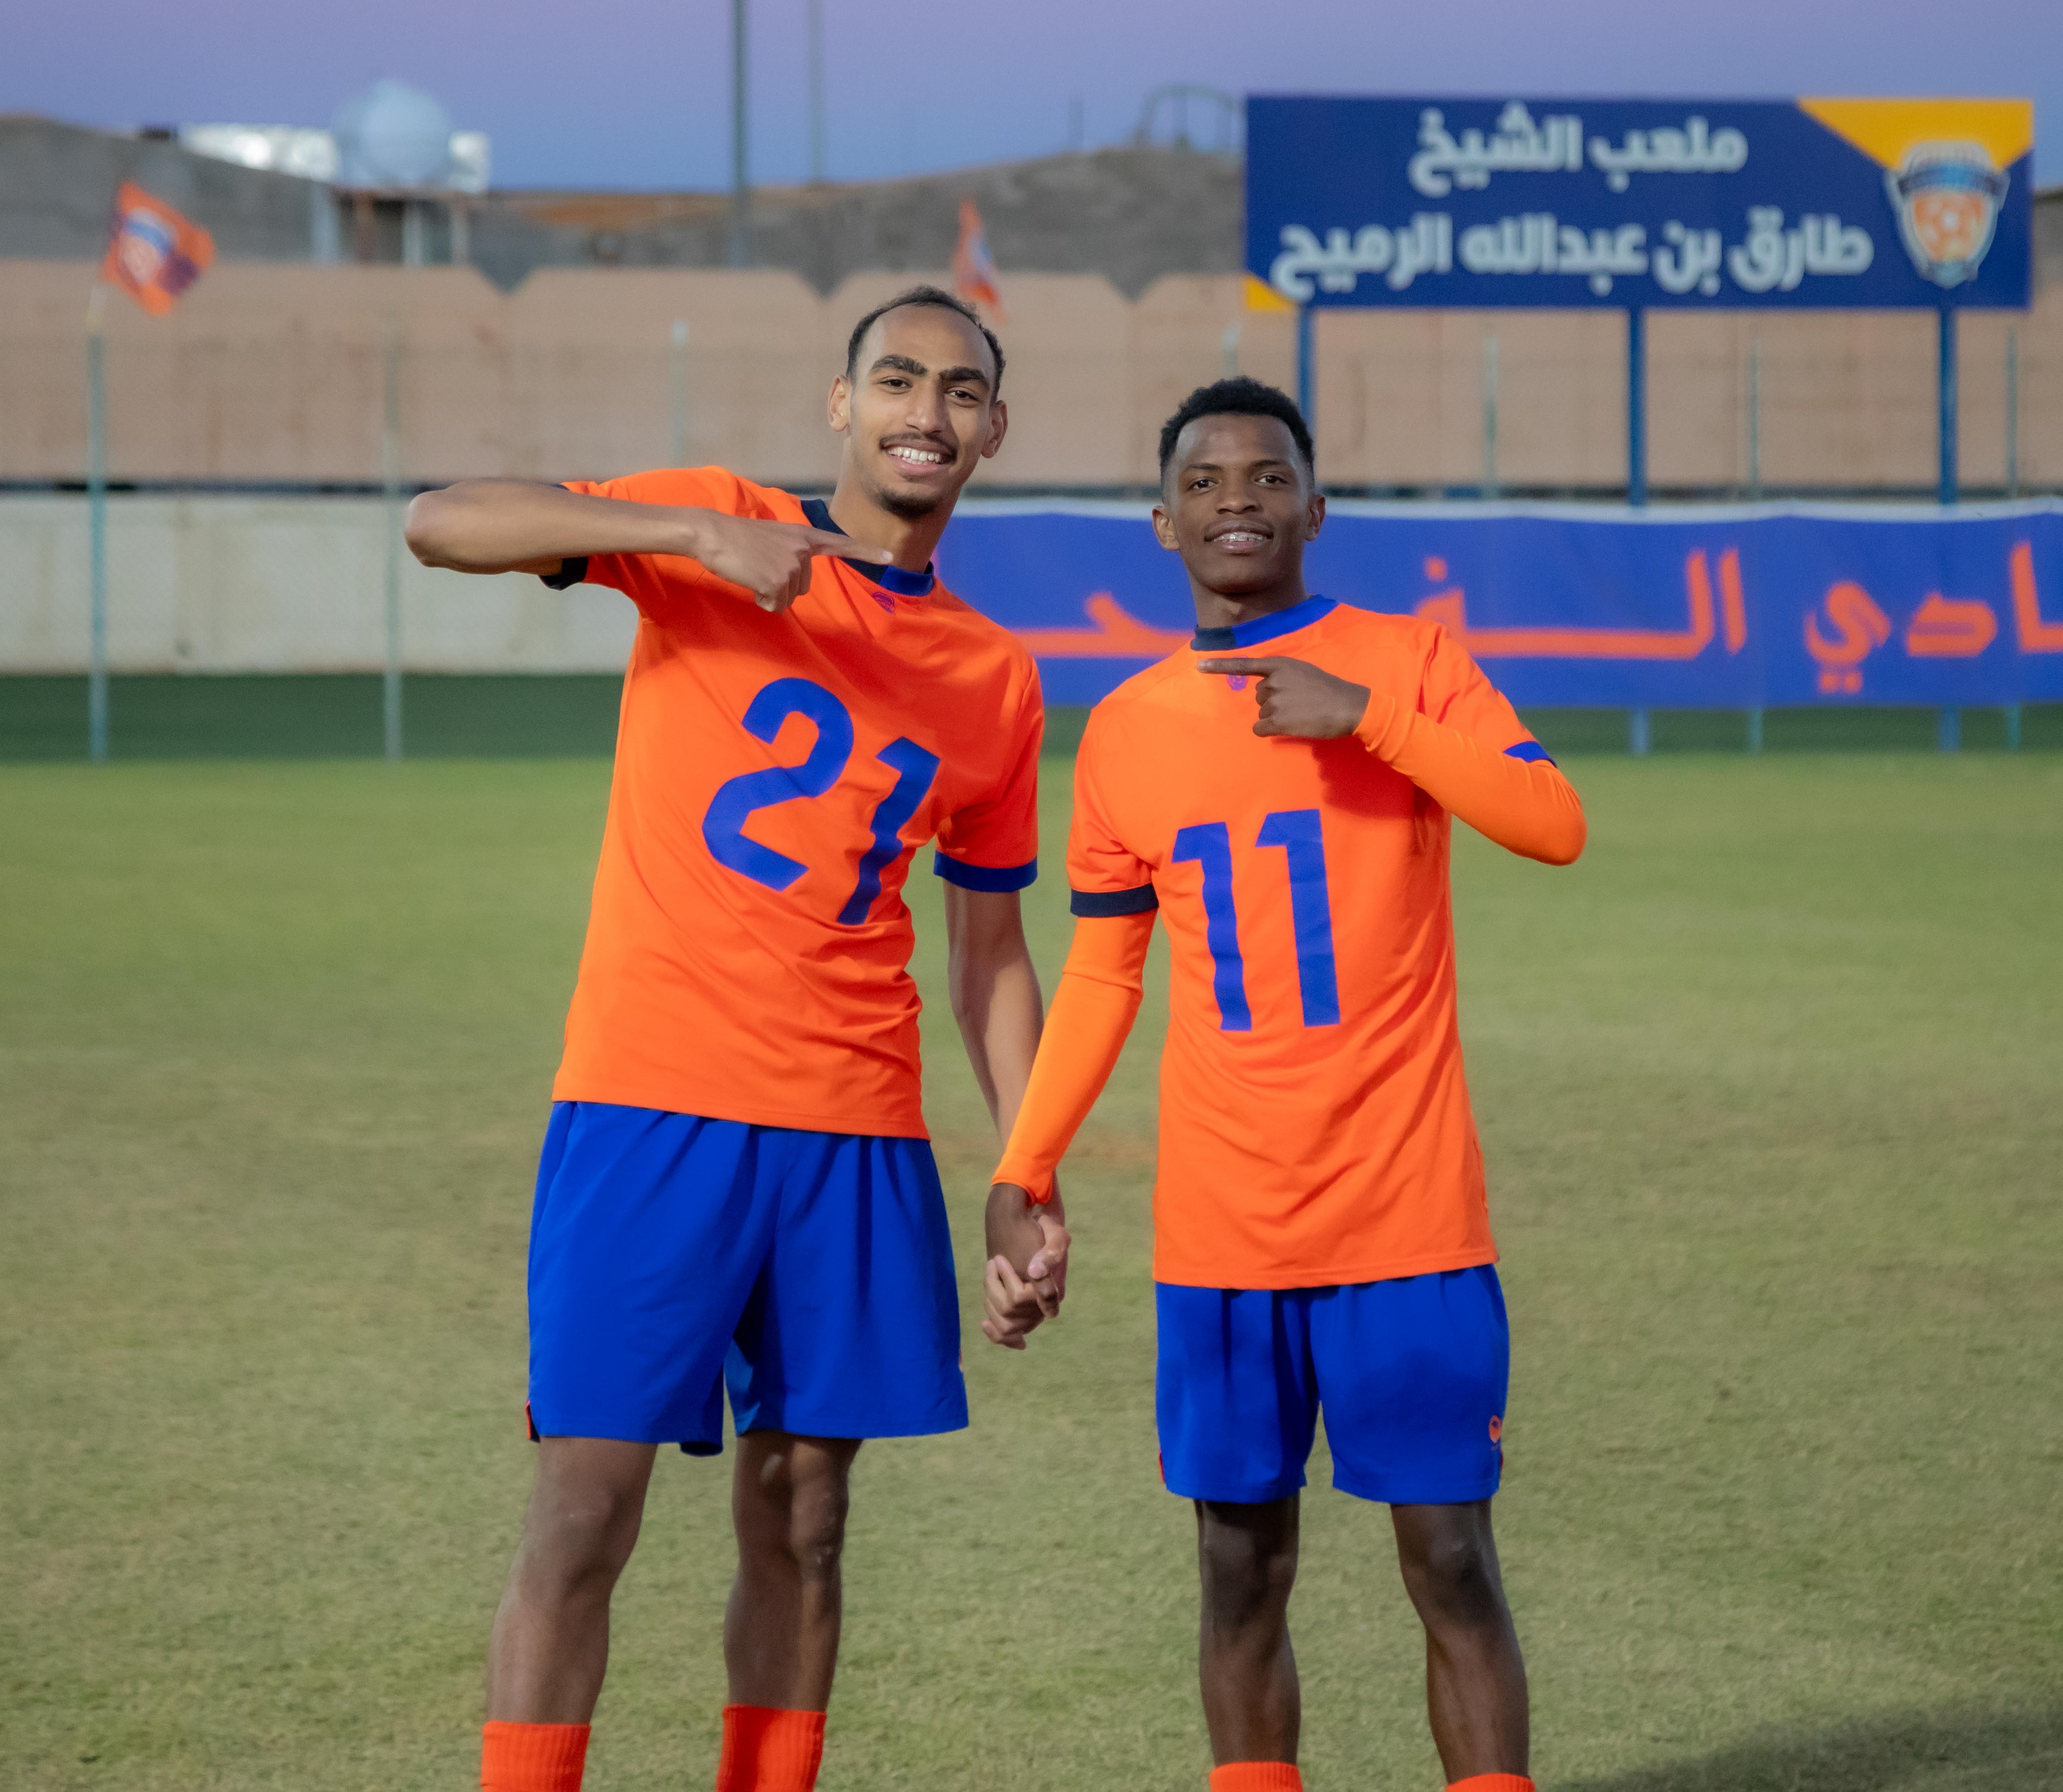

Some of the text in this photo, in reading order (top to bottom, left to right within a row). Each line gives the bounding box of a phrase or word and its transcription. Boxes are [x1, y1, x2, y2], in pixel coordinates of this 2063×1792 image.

[1408, 101, 1749, 198] ملعب الشيخ
[1269, 205, 1874, 302] طارق بن عبدالله الرميح
[1805, 542, 2063, 693] ادي
[702, 677, 940, 925] 21
[1172, 809, 1341, 1031] 11
